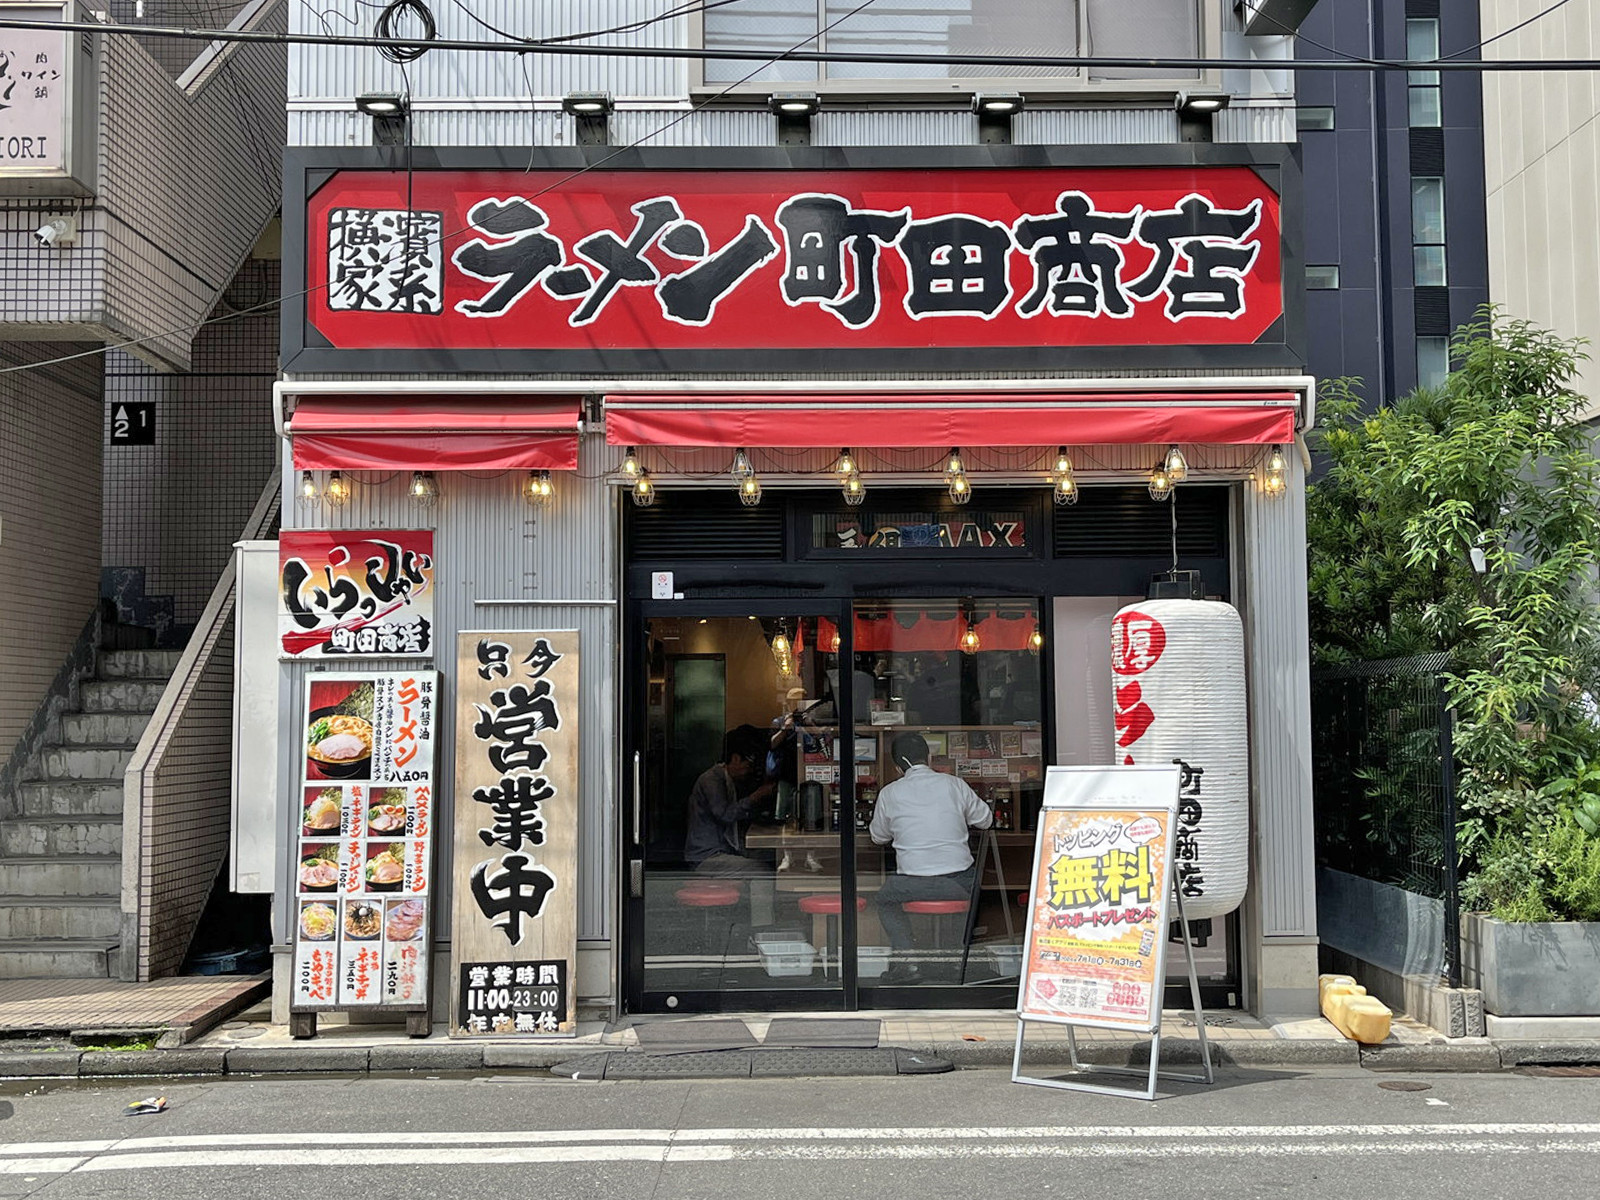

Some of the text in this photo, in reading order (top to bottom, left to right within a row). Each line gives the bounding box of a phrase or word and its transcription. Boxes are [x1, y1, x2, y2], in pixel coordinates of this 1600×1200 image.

[21, 70, 61, 80] ワイン
[114, 420, 129, 437] 2
[139, 410, 146, 427] 1
[393, 678, 420, 768] ラーメン
[470, 677, 562, 946] 営業中
[1054, 823, 1123, 853] トッピング
[1046, 845, 1154, 911] 無料
[1047, 907, 1157, 929] パスポートプレゼント
[468, 965, 559, 987] 営業時間
